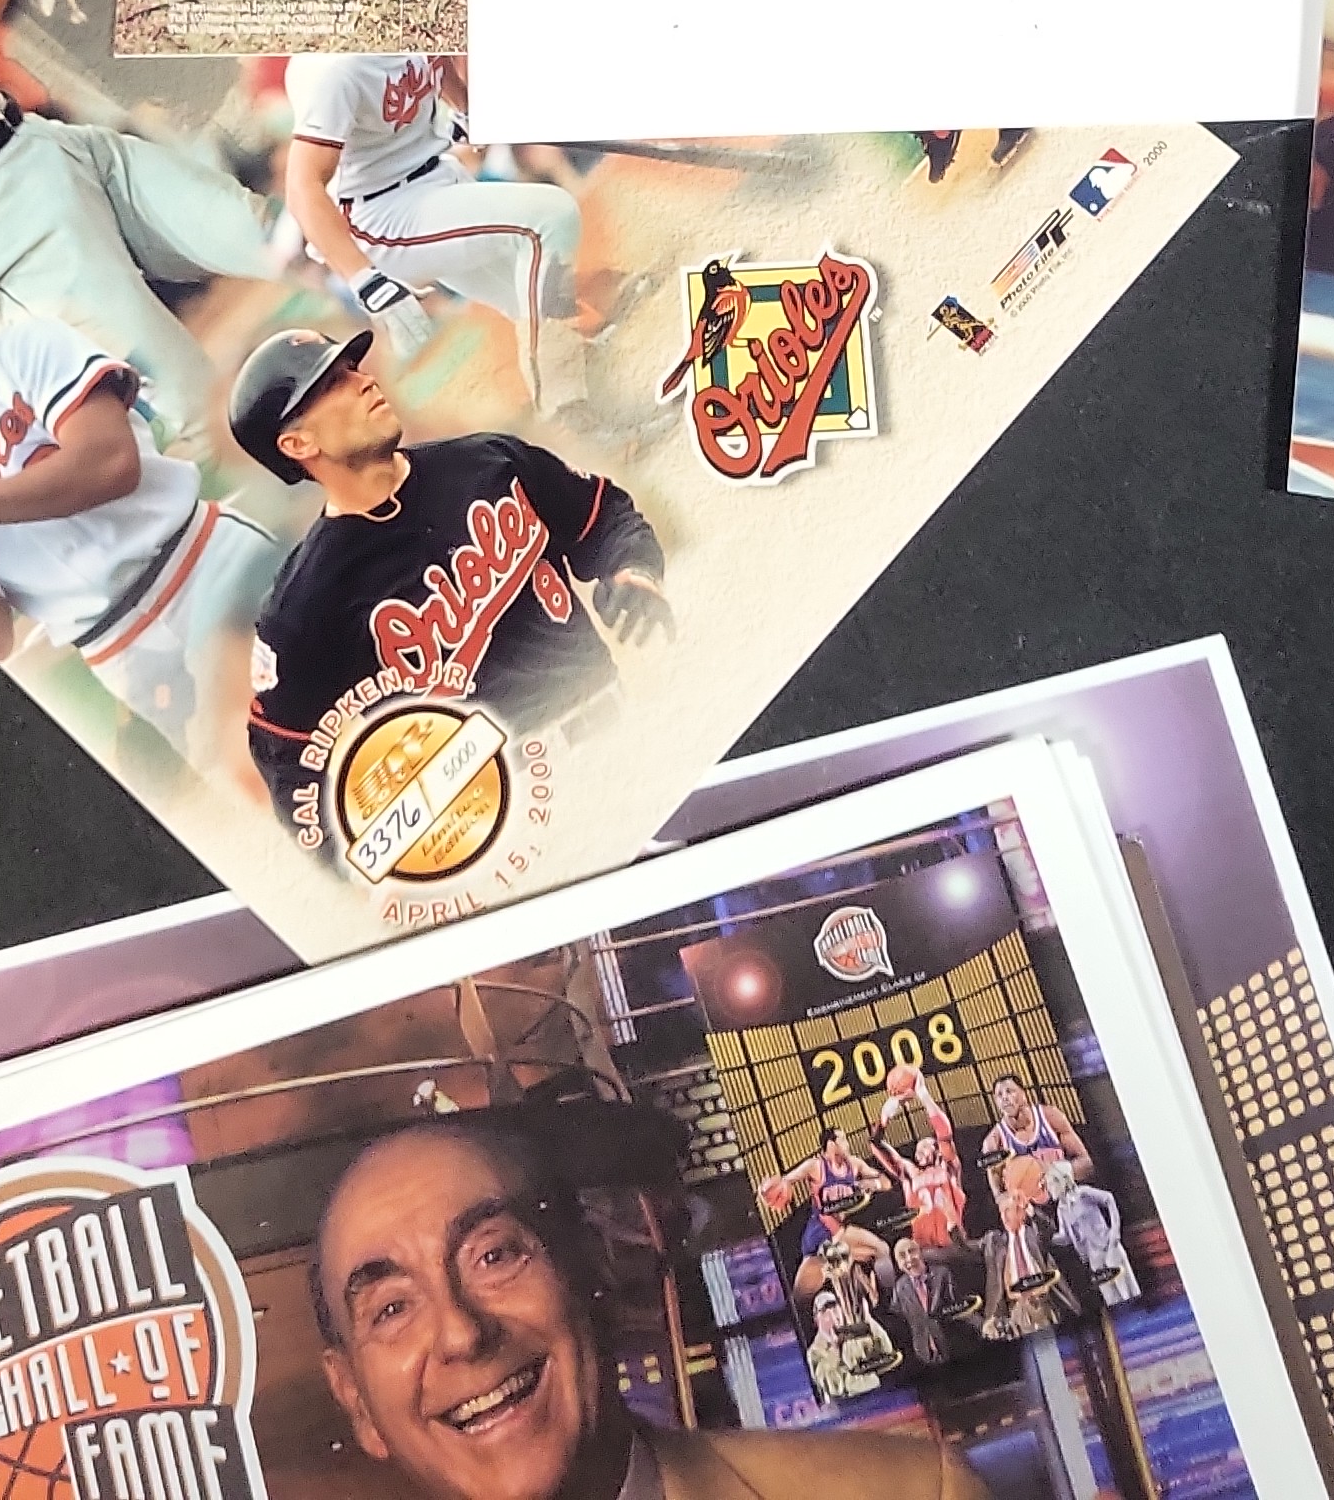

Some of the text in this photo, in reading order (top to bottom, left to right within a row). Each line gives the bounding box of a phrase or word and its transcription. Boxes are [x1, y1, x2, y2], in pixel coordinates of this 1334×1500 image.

[1142, 140, 1169, 167] 2000
[999, 247, 1055, 310] Photo File
[692, 252, 871, 479] Orioles
[534, 559, 571, 624] 8
[358, 798, 421, 870] 3376
[383, 891, 485, 924] APRIL
[522, 740, 554, 826] 2000
[811, 1012, 964, 1106] 2008
[0, 1312, 203, 1433] HALL OF
[74, 1409, 229, 1500] FAME
